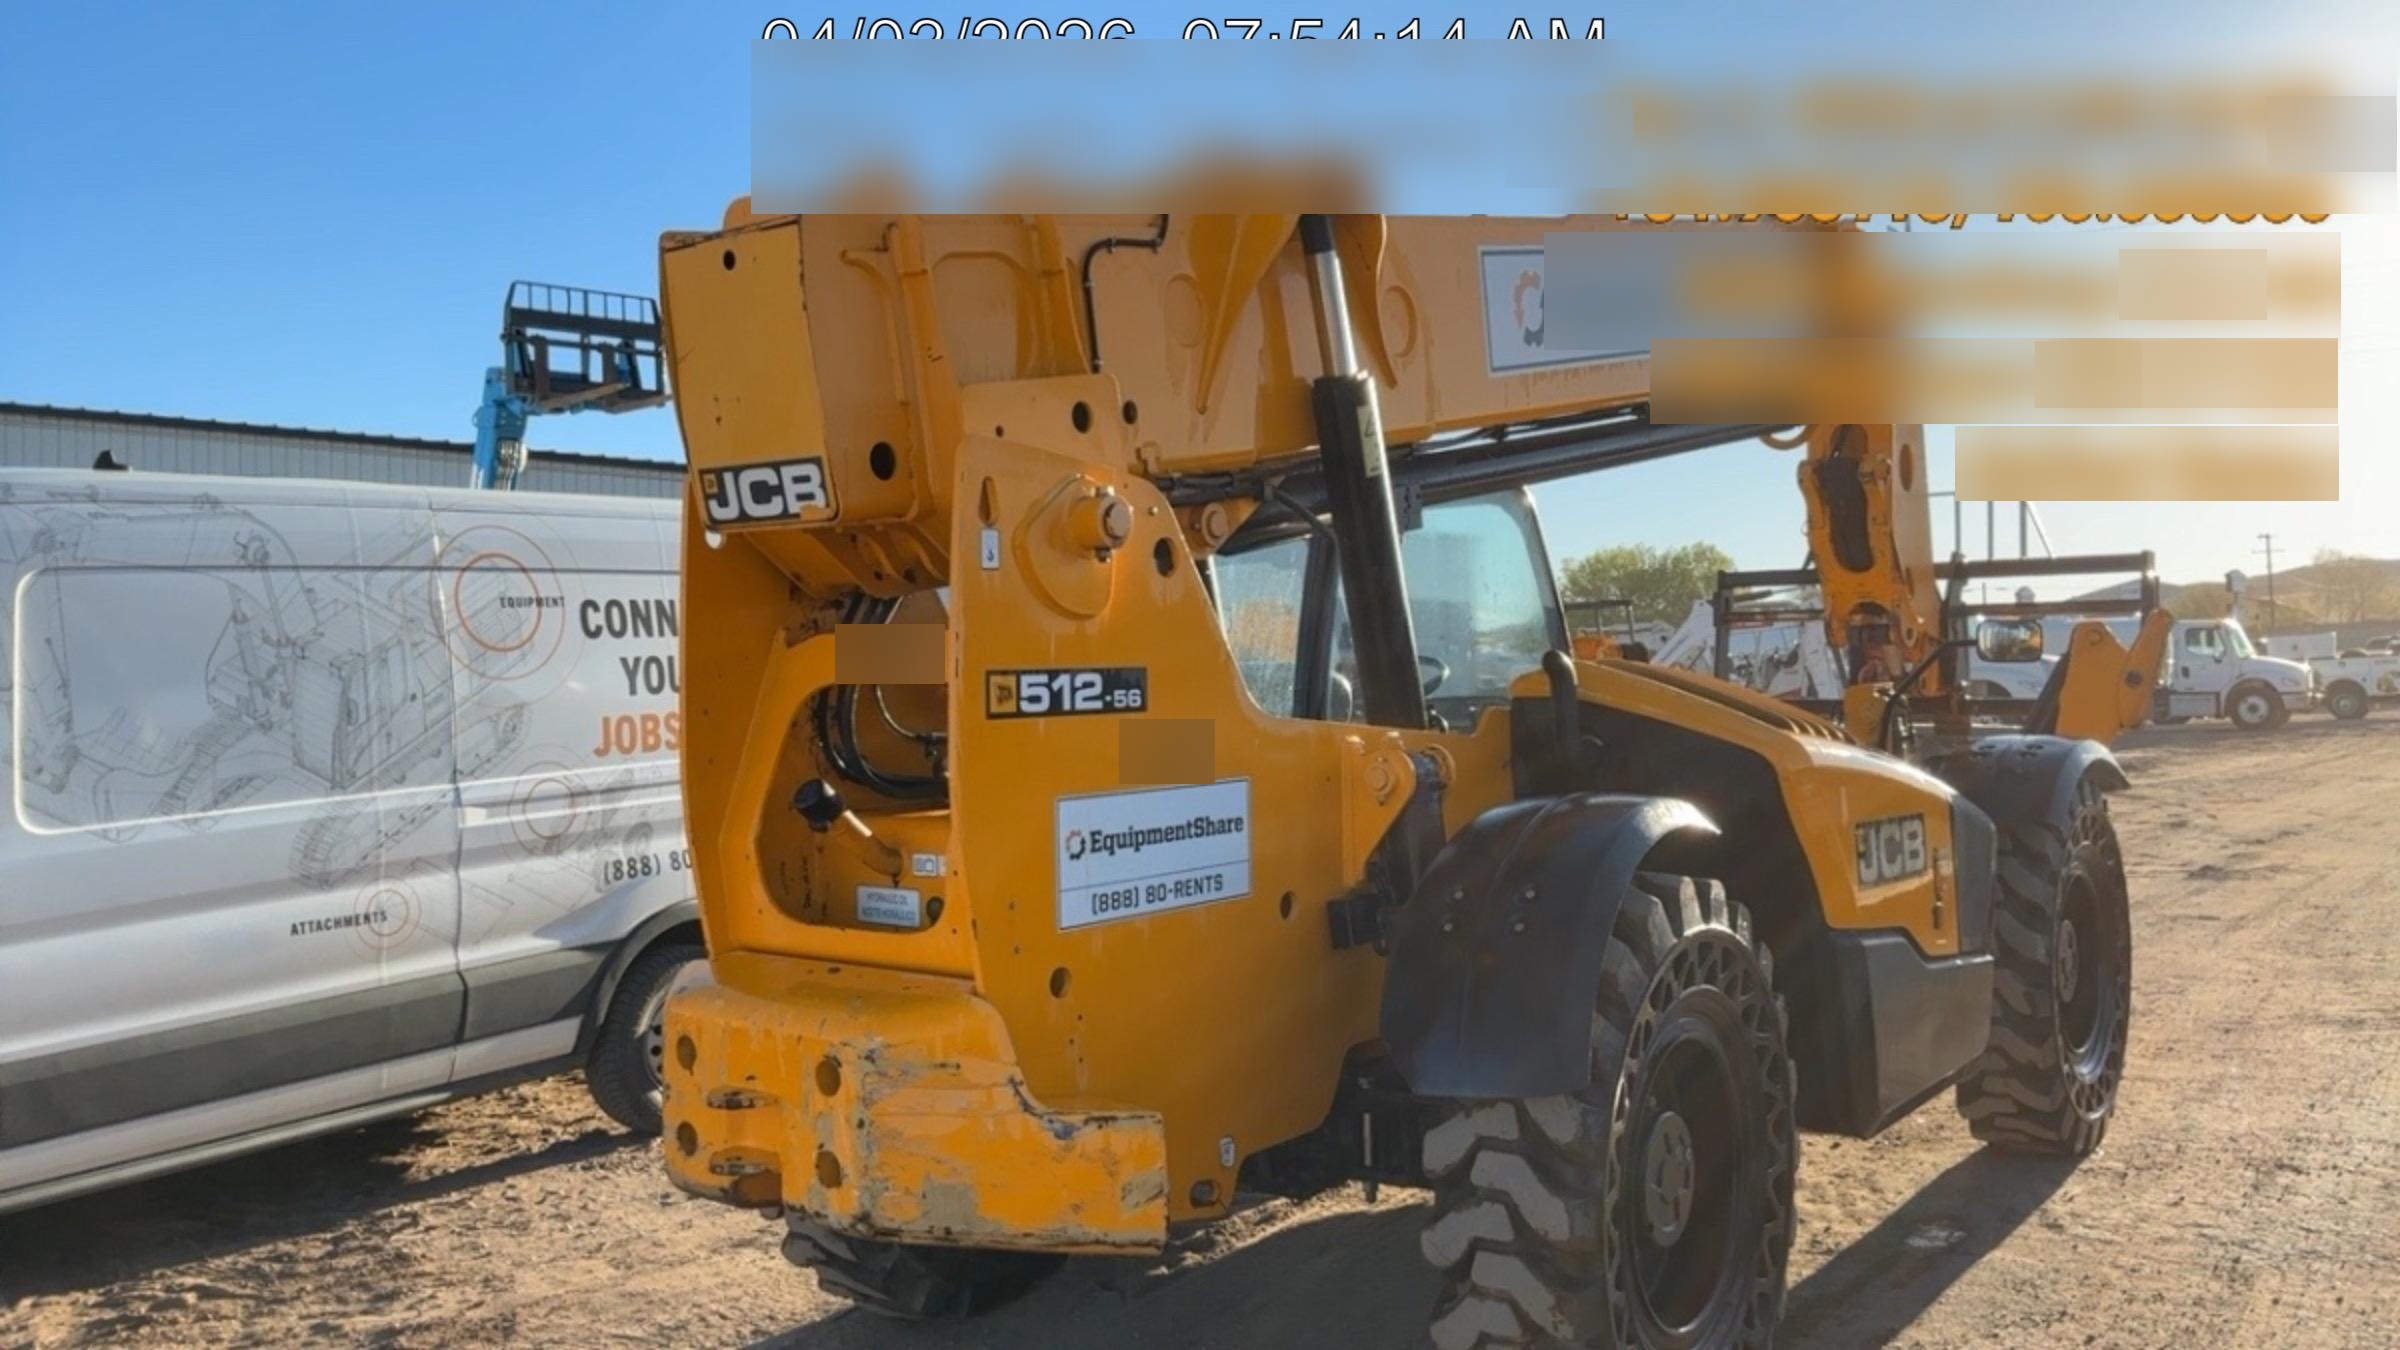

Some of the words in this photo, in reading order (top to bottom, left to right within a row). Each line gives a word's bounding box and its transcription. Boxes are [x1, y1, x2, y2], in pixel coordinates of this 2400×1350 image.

[708, 463, 827, 520] JCB
[500, 596, 565, 609] EQUIPMENT
[1019, 672, 1142, 713] 512-56
[1089, 816, 1244, 856] EquipmentShare
[1860, 818, 1925, 883] JCB
[604, 853, 661, 885] (888)
[1091, 886, 1140, 915] (888)
[1145, 873, 1224, 904] 80-RENTS
[289, 909, 388, 936] ATTACHMENTS
